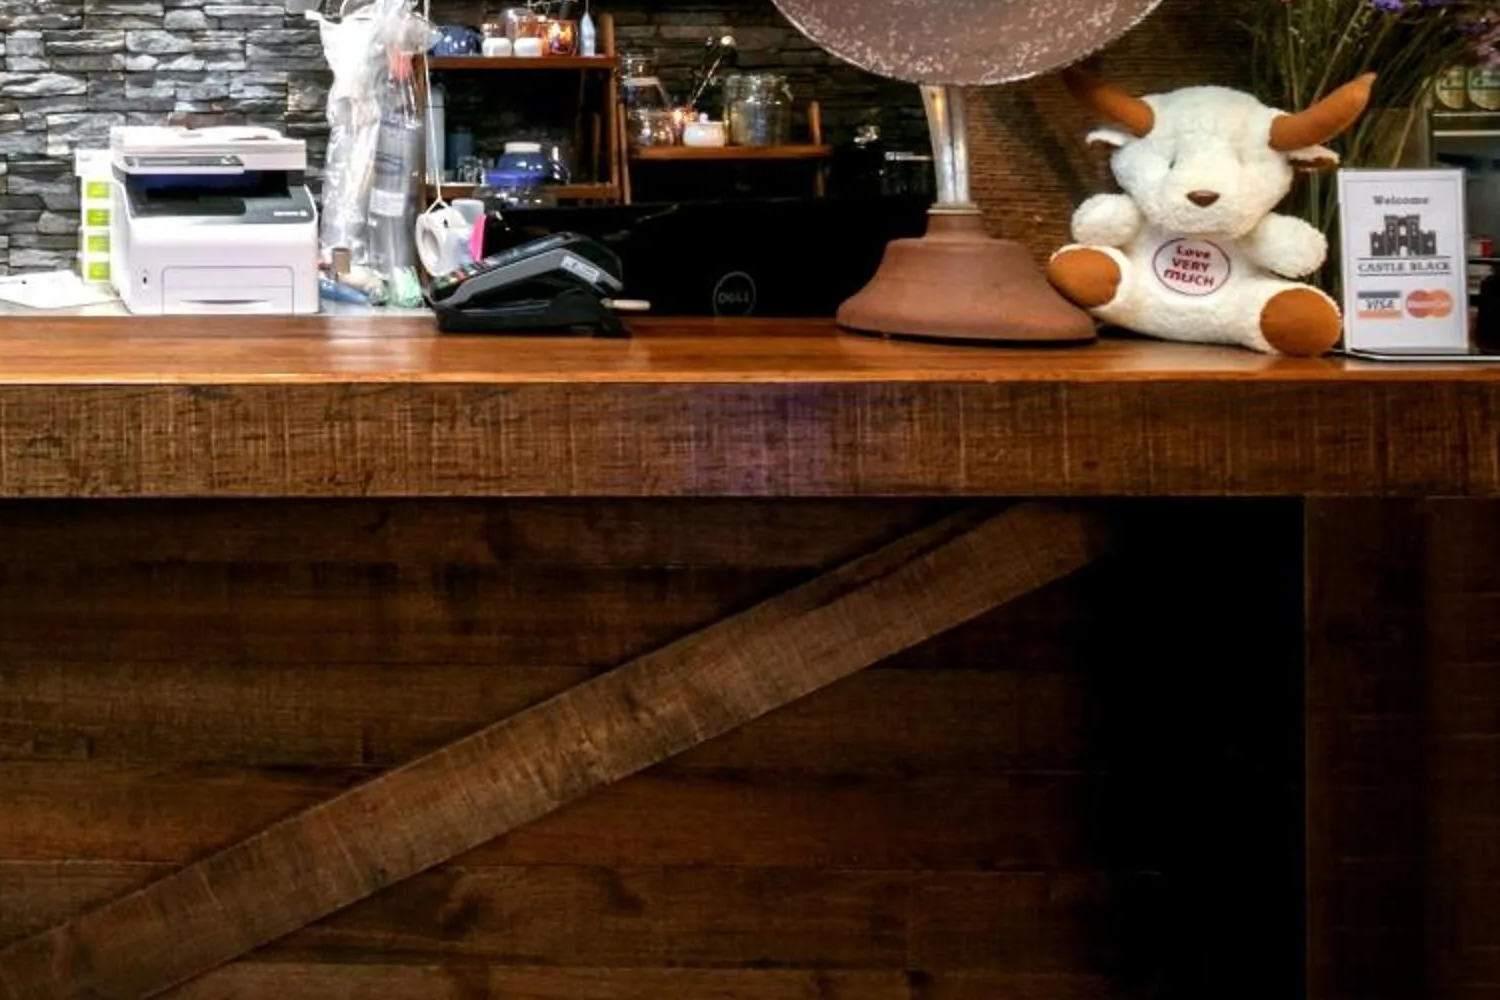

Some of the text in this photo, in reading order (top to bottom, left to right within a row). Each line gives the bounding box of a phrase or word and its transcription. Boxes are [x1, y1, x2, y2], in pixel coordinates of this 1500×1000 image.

[1372, 194, 1429, 205] Welcome
[1175, 244, 1211, 259] Love
[1171, 257, 1211, 272] VERY
[1357, 260, 1452, 273] CASTLE BLACK
[1364, 299, 1395, 310] VISA
